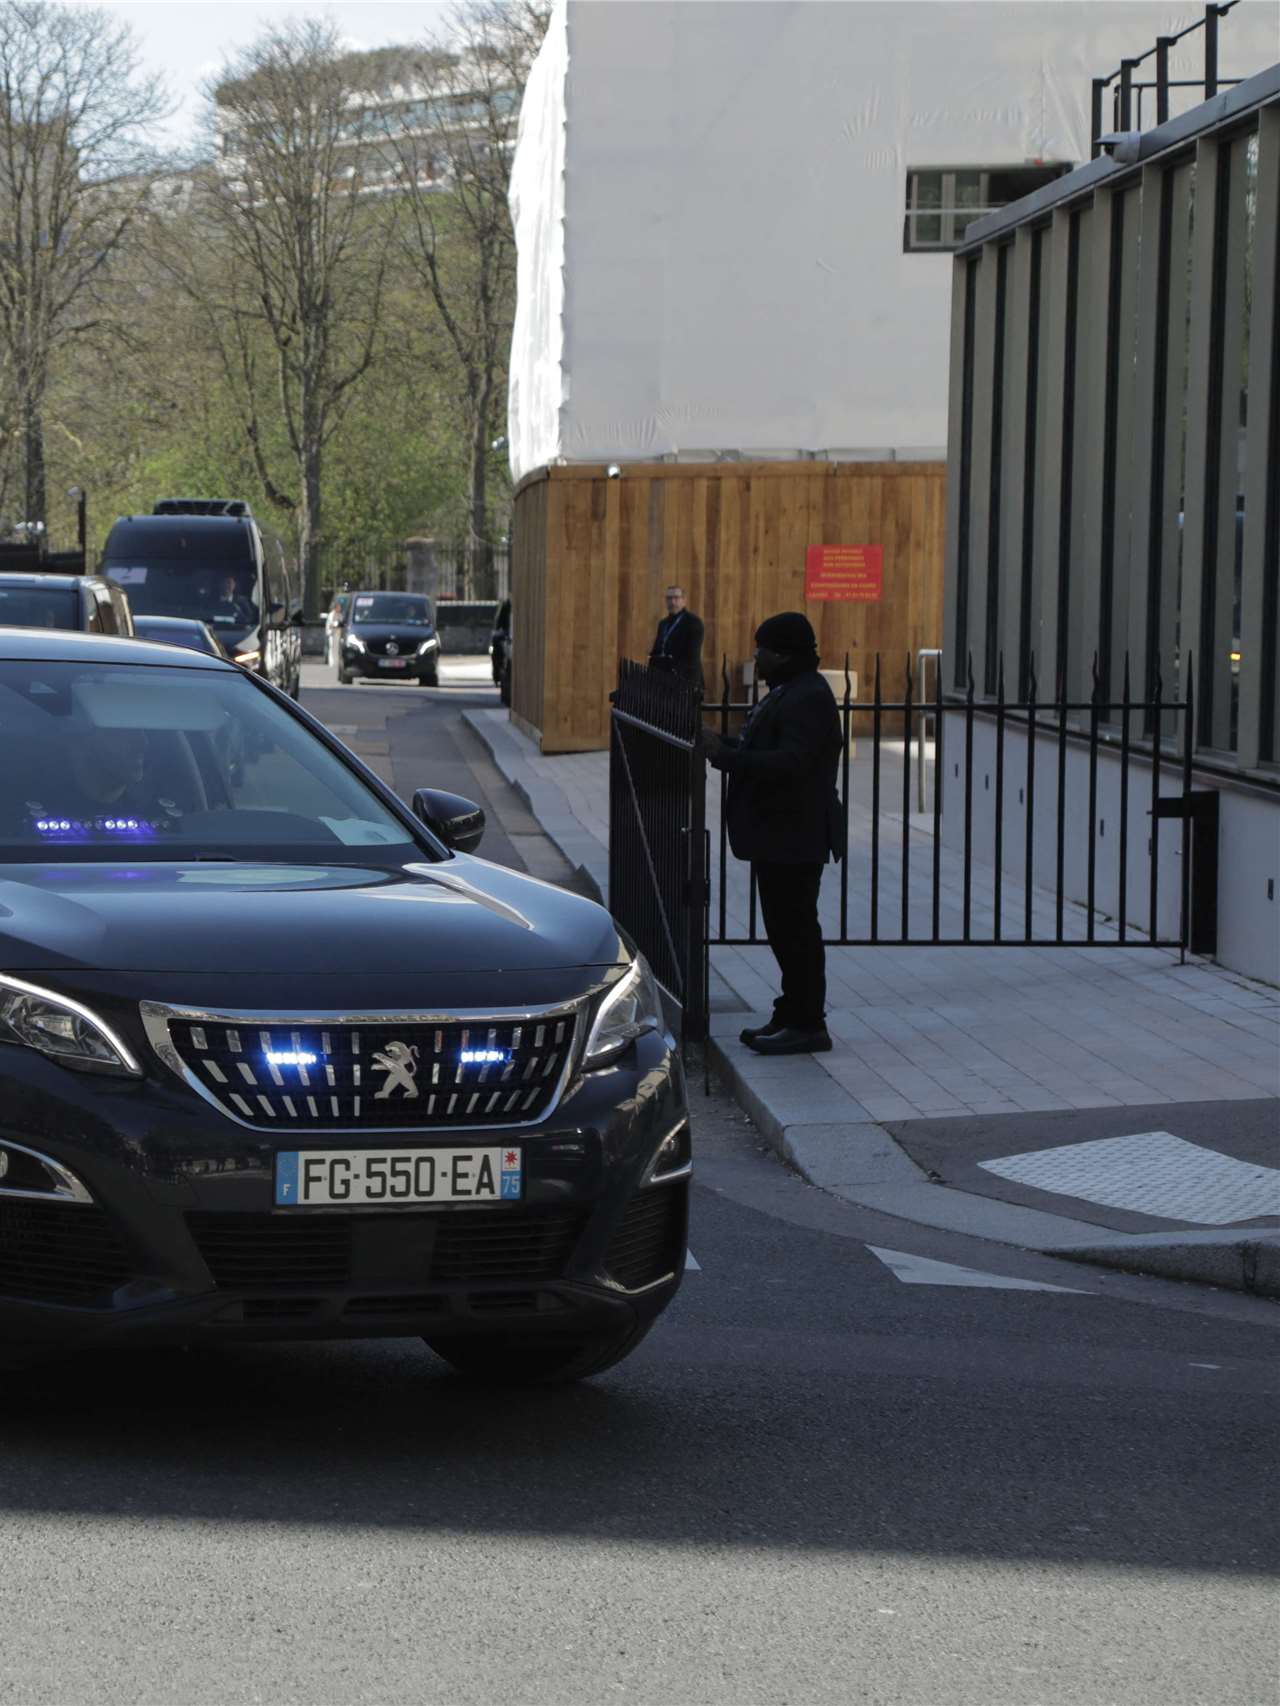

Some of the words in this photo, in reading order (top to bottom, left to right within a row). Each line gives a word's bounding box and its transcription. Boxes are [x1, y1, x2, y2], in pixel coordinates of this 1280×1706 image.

[303, 1154, 496, 1201] FG-550-EA
[502, 1174, 520, 1194] 75
[282, 1183, 291, 1197] F
